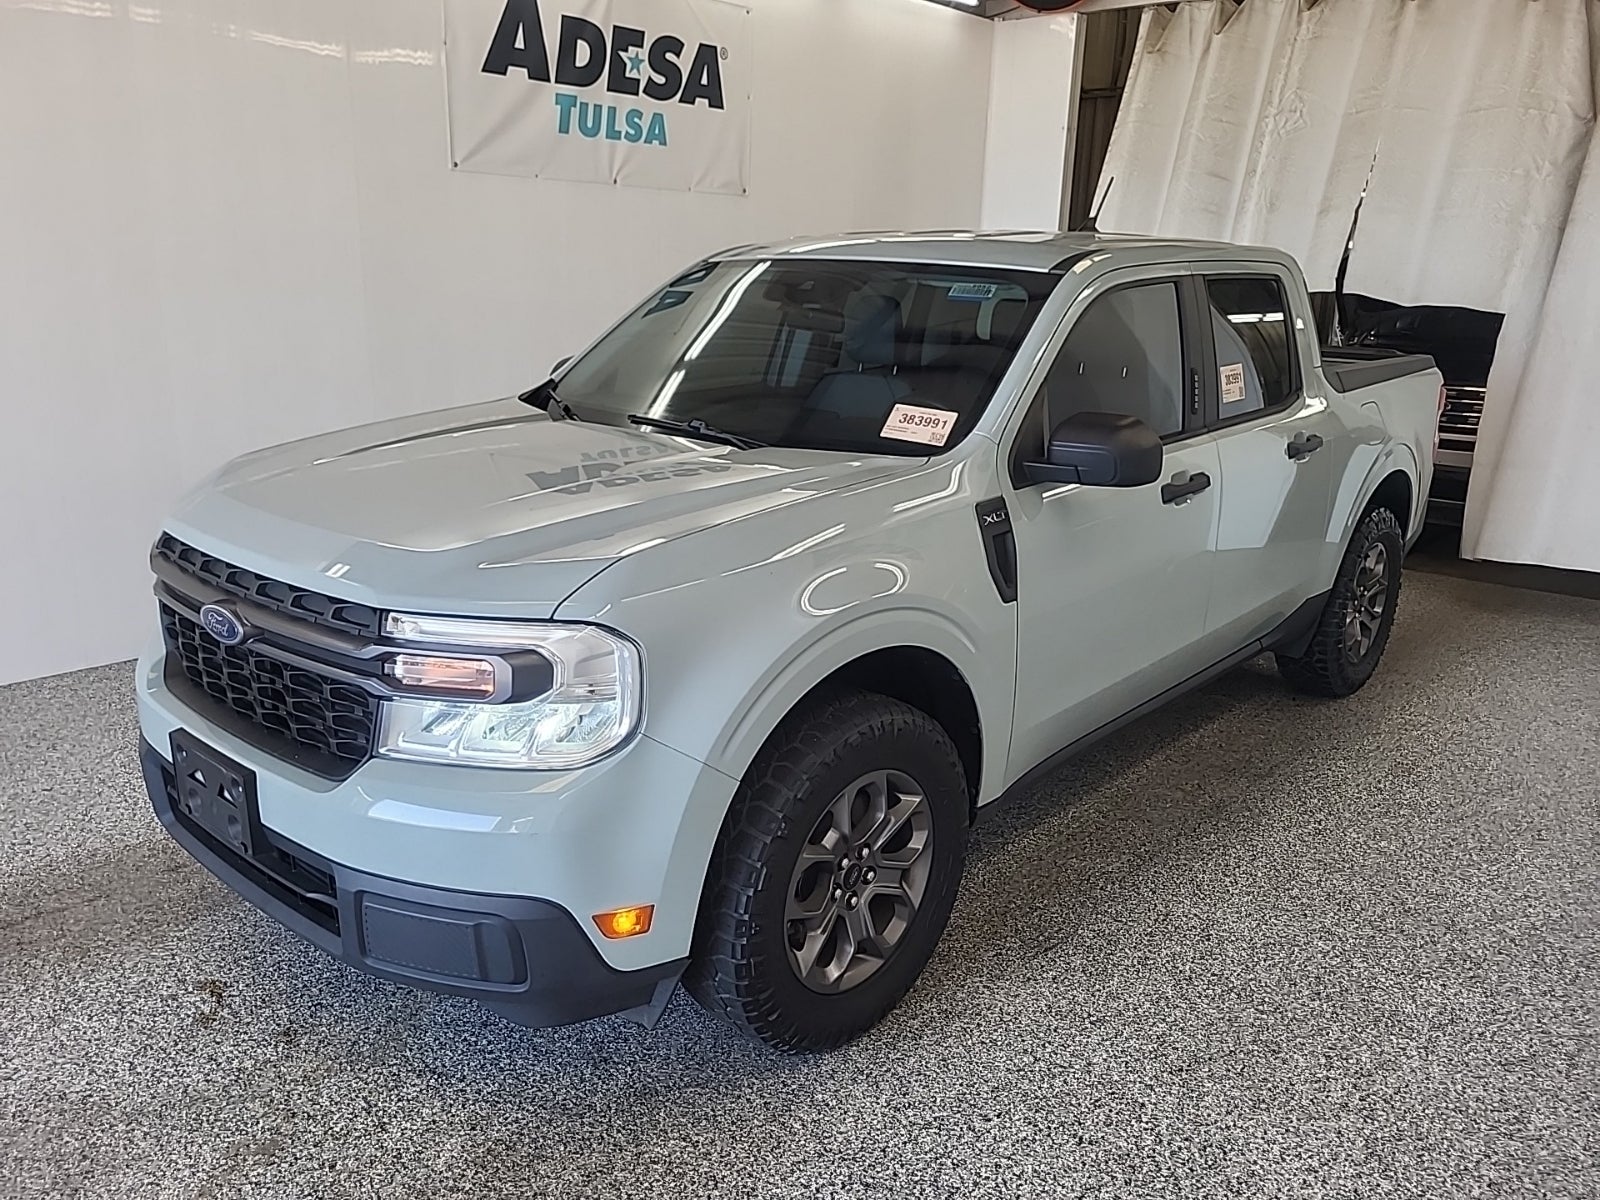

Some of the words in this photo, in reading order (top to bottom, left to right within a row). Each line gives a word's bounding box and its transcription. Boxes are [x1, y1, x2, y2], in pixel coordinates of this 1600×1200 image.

[481, 0, 725, 110] ADESA
[554, 92, 668, 147] TULSA
[898, 413, 948, 430] 383991
[982, 511, 1006, 526] XLT
[207, 612, 230, 637] Ford
